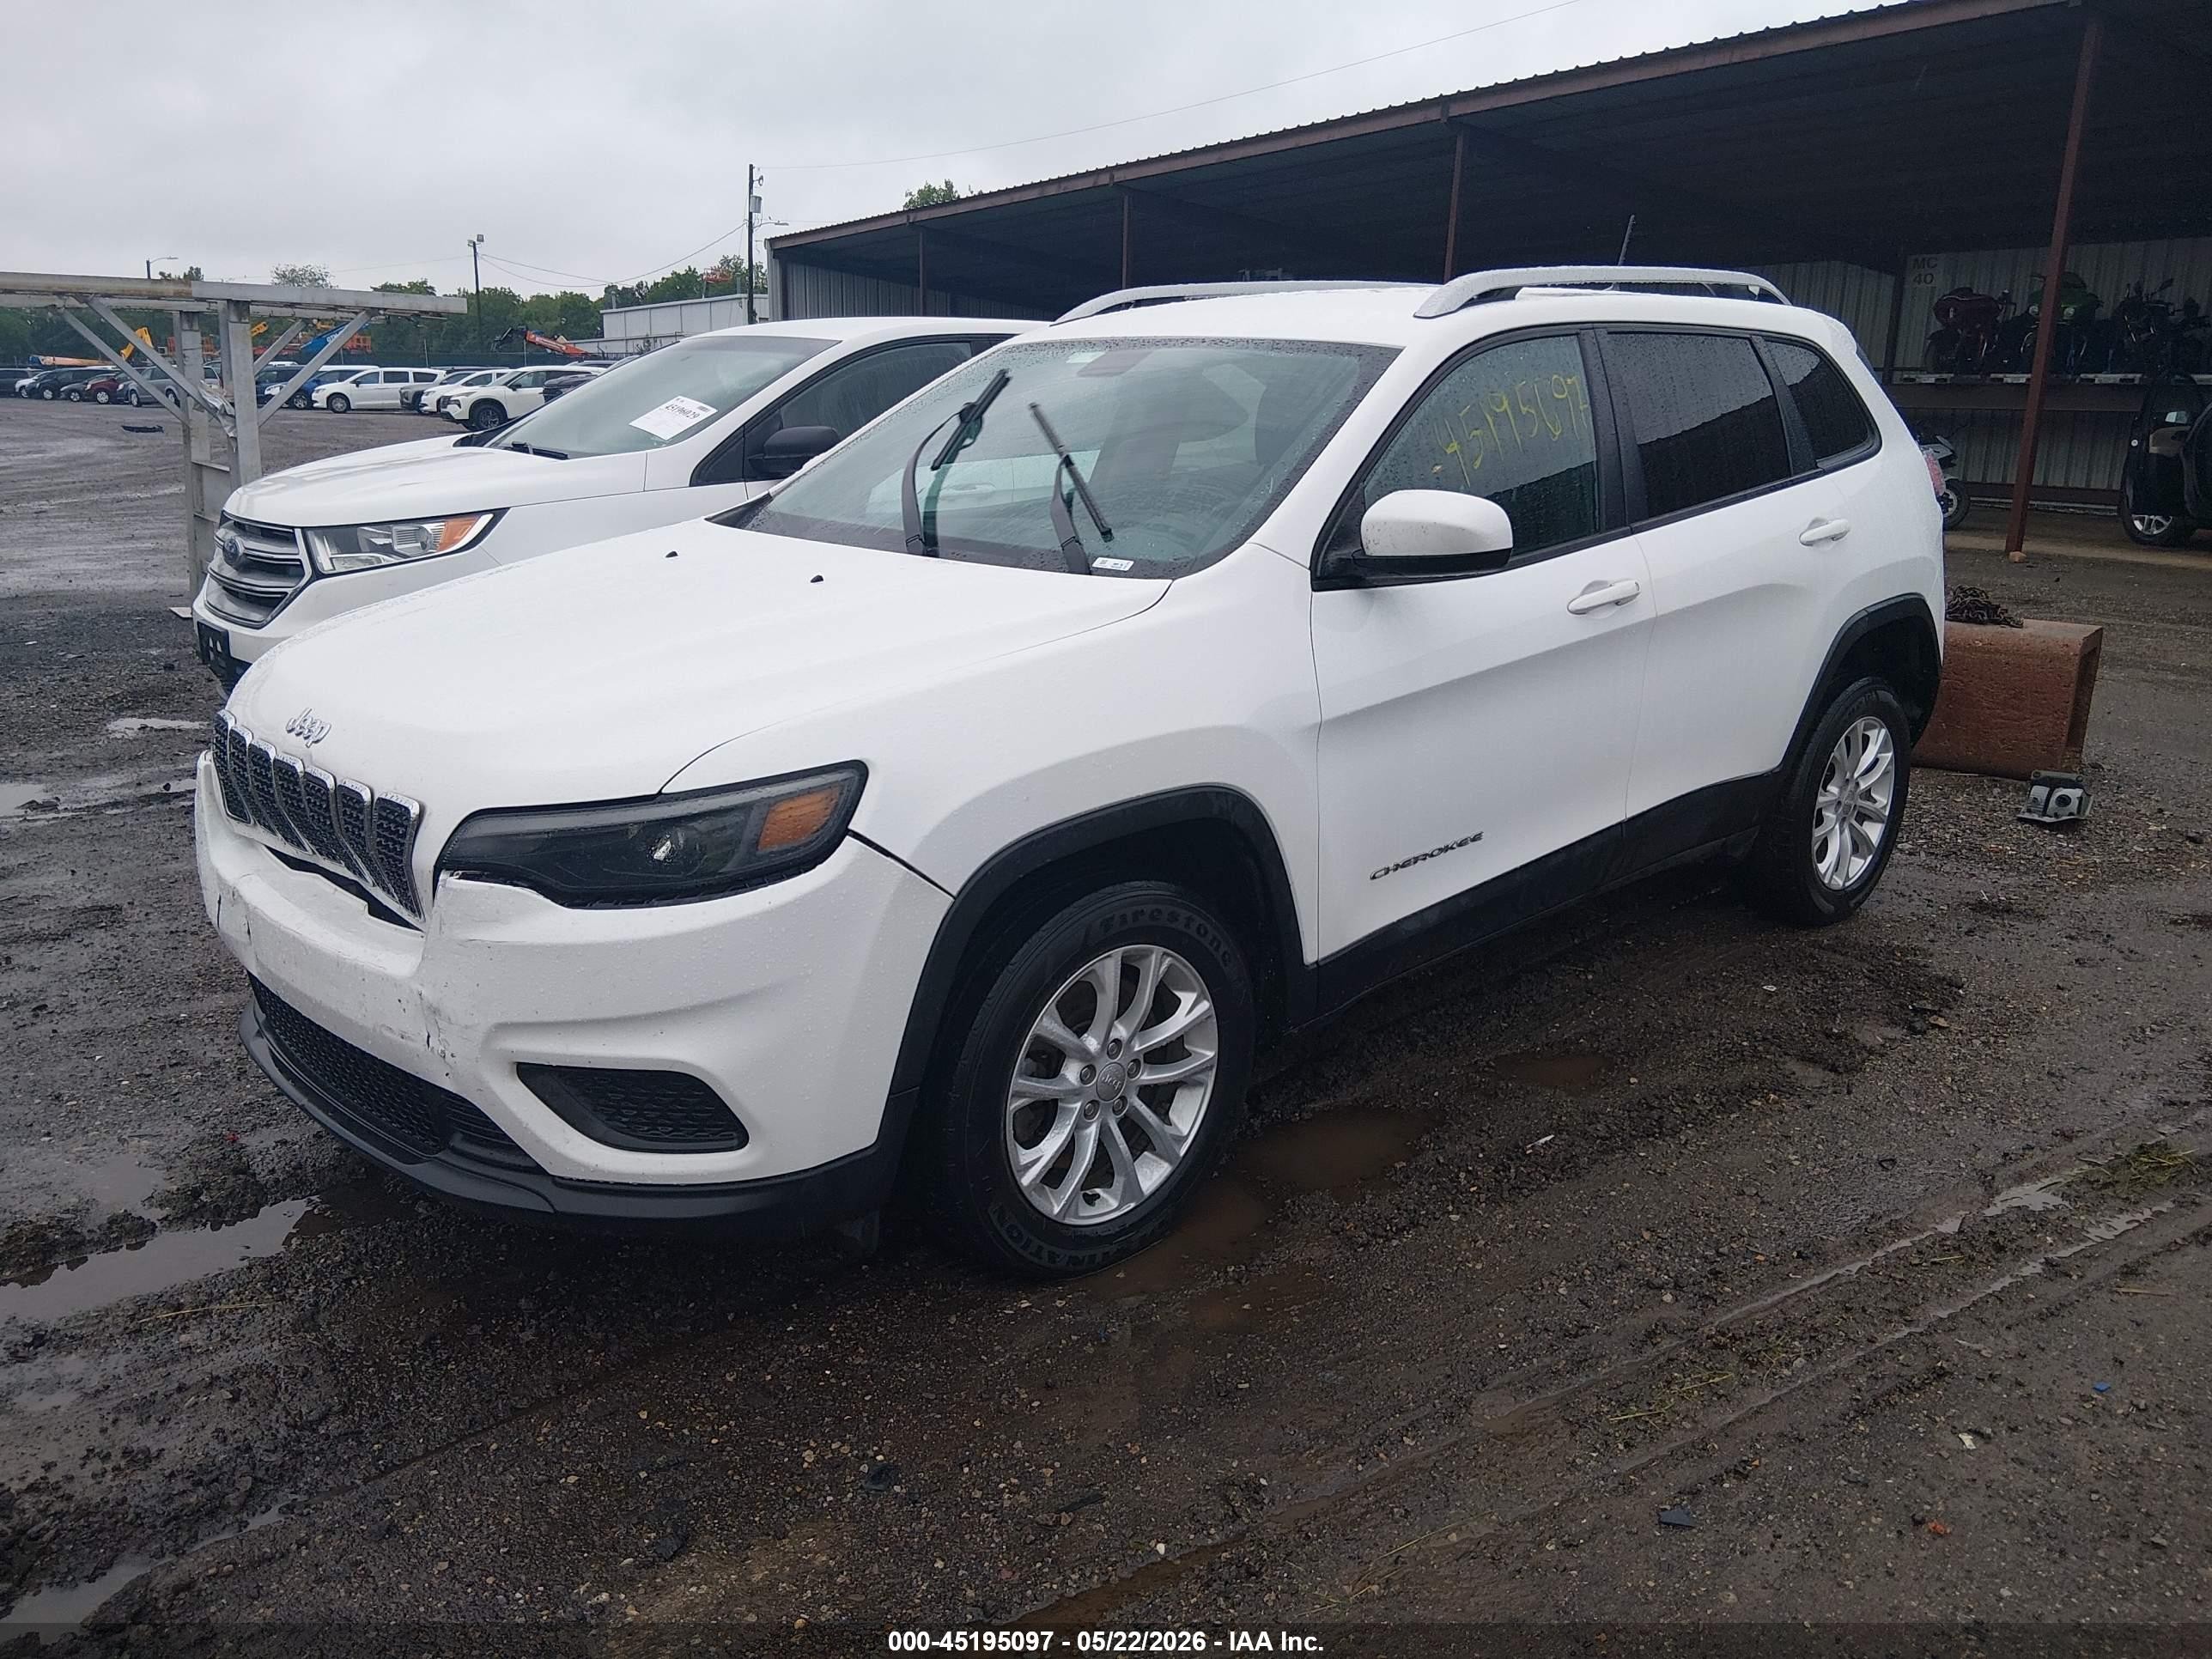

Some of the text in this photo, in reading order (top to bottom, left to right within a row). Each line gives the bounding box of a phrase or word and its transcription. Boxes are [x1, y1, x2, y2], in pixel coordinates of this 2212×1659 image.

[1914, 258, 1937, 269] MC
[1913, 273, 1934, 285] 40
[285, 707, 332, 749] Jeep
[1370, 830, 1485, 880] CHEROKEE
